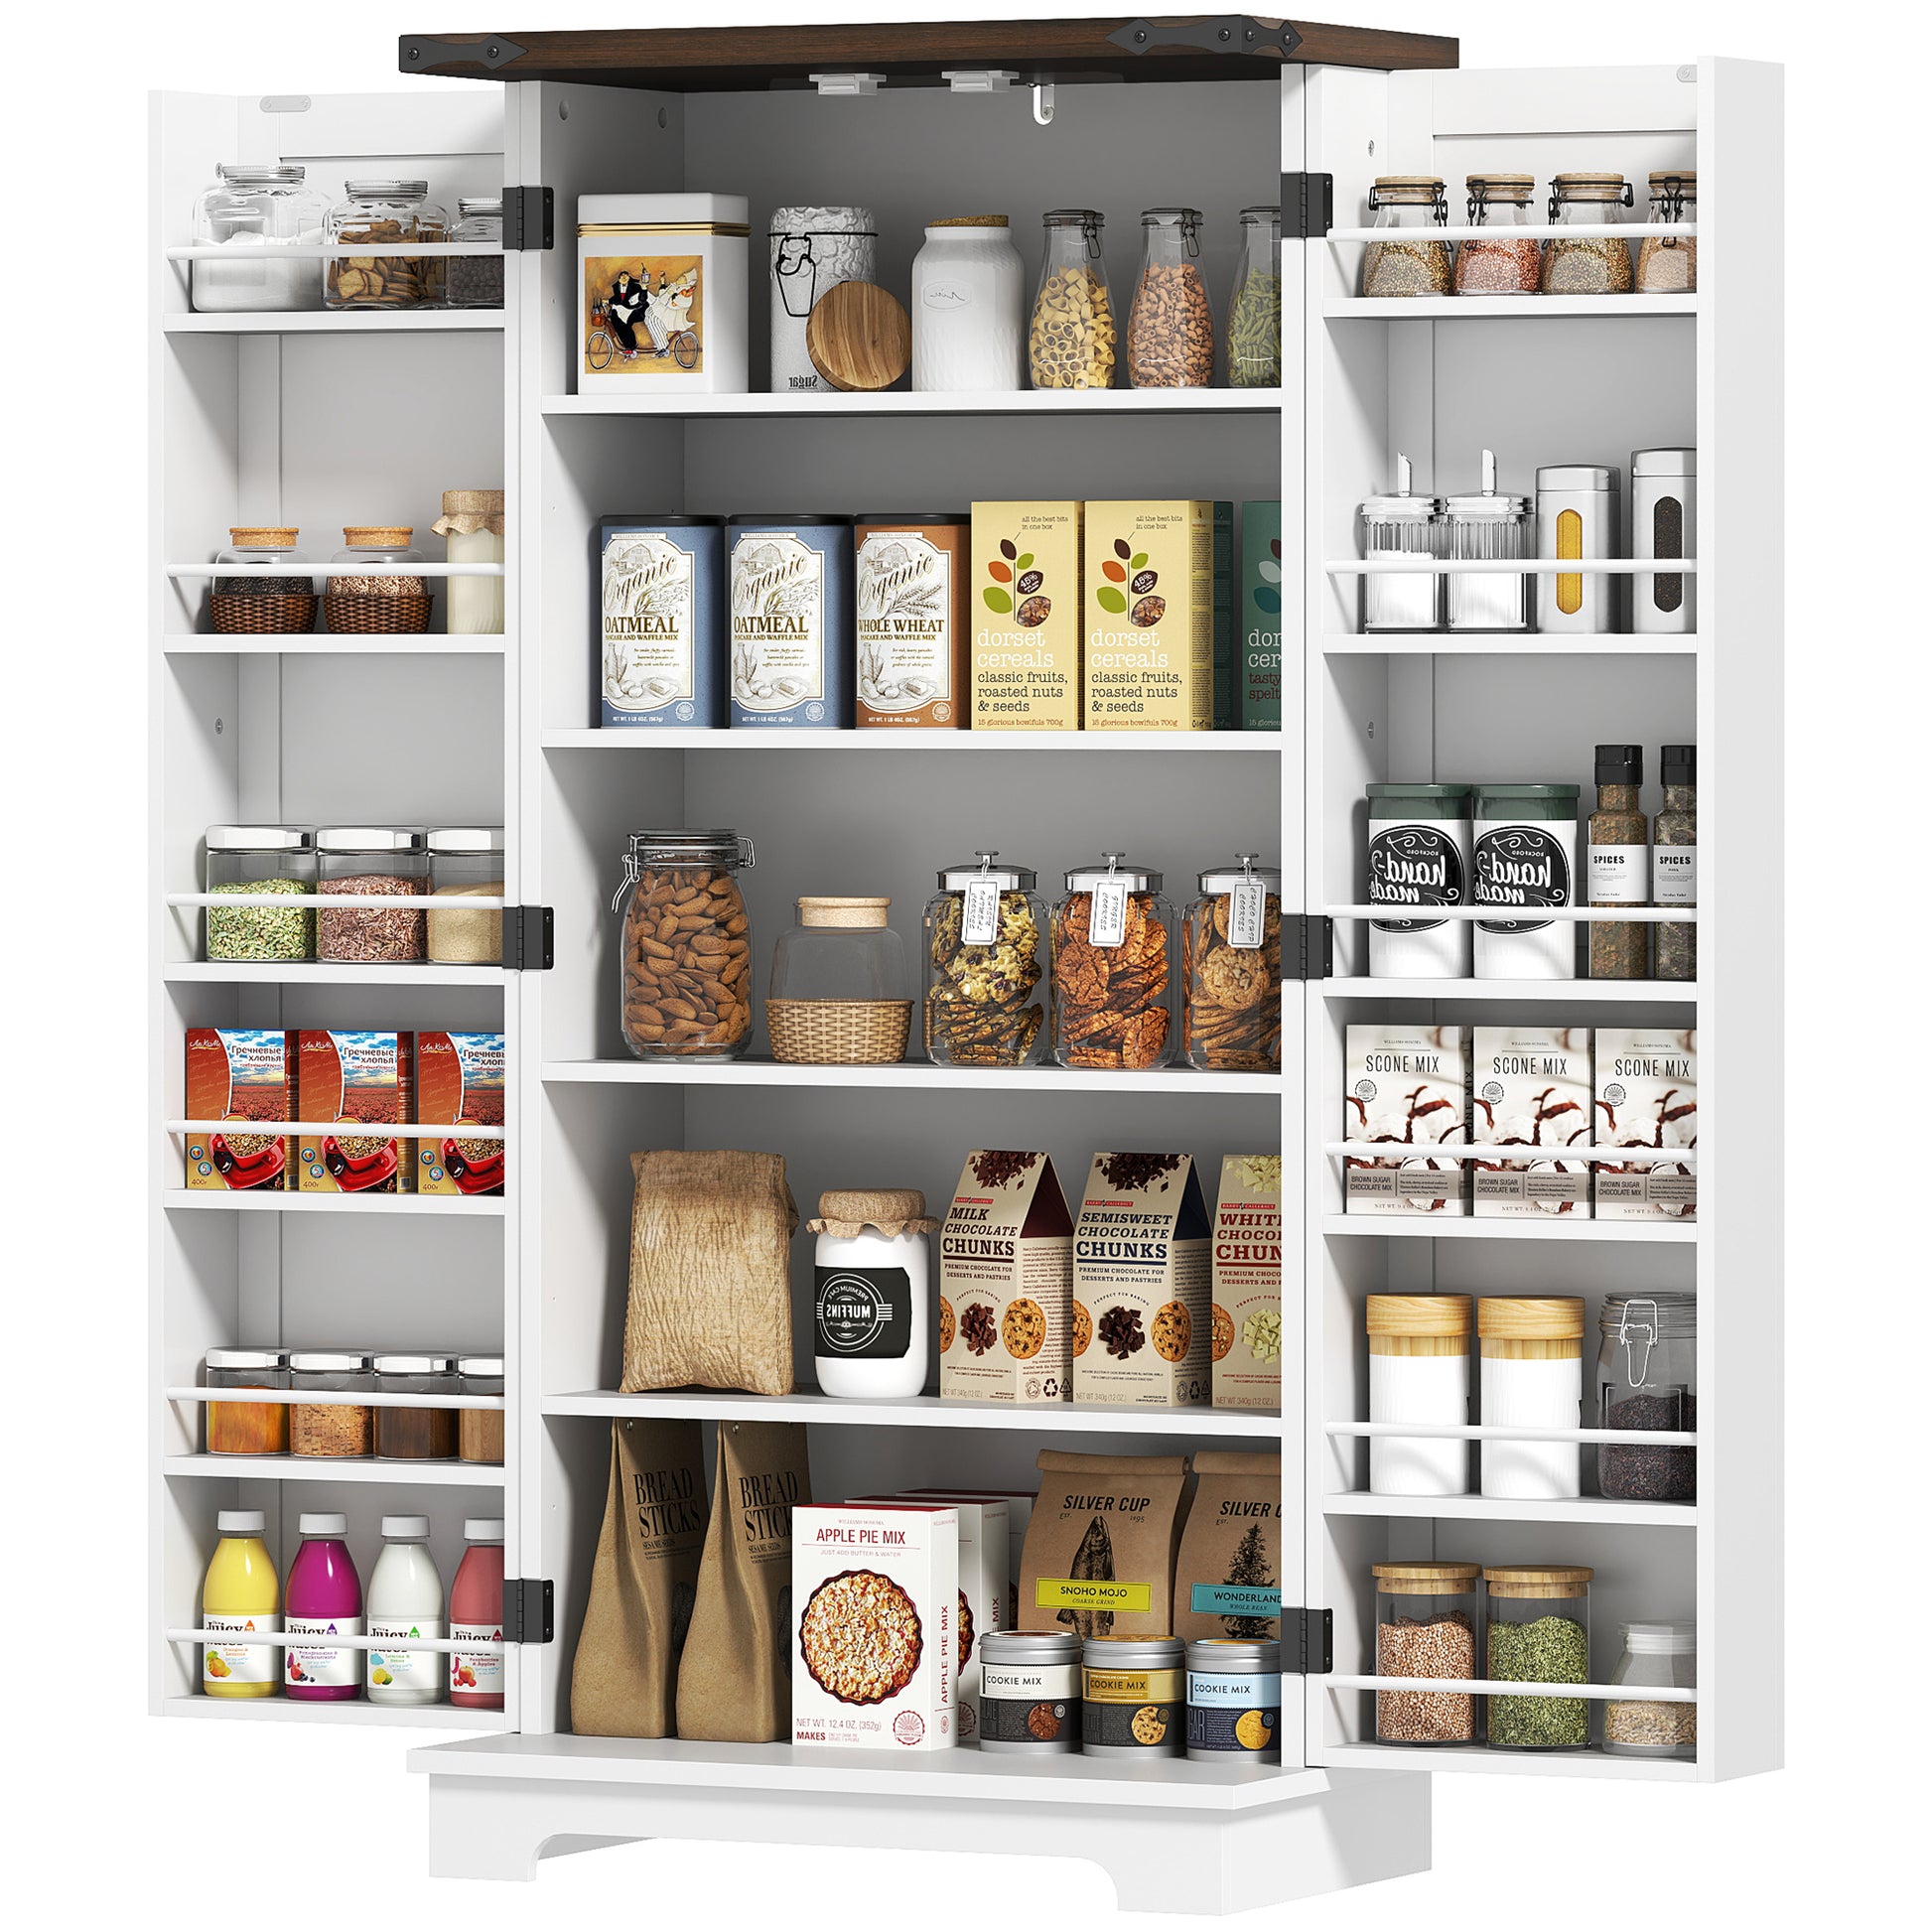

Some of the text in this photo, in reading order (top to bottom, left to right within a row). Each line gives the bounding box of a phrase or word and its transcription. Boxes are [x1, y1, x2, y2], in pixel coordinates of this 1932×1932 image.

[604, 554, 677, 614] Organic
[733, 553, 807, 614] Organic
[859, 553, 934, 614] Organic
[606, 617, 679, 633] OATMEAL
[734, 616, 809, 633] OATMEAL
[859, 619, 944, 632] WHOLE WHEAT
[977, 628, 1045, 646] dorset
[1091, 628, 1160, 646] dorset
[977, 650, 1054, 667] cereals
[1091, 650, 1169, 667] cereals
[978, 671, 1068, 685] classic fruits,
[1092, 671, 1182, 685] classic fruits,
[1249, 672, 1281, 685] tasty
[978, 686, 1063, 697] roasted nuts
[1092, 686, 1177, 697] roasted nuts
[978, 701, 1030, 712] & seeds
[1092, 701, 1144, 712] & seeds
[987, 719, 1014, 728] glorious
[1045, 719, 1063, 728] 700g
[1101, 719, 1128, 728] glorious
[1160, 719, 1177, 728] 700g
[1593, 855, 1625, 865] SPICES
[1659, 856, 1691, 865] SPICES
[231, 1045, 281, 1055] Гречневые
[344, 1047, 394, 1057] Гречневые
[1366, 1054, 1440, 1073] SCONE MIX
[1493, 1056, 1567, 1075] SCONE MIX
[1615, 1059, 1690, 1077] SCONE MIX
[949, 1207, 990, 1220] MILK
[1081, 1212, 1173, 1225] SEMISWEET
[944, 1223, 1018, 1236] CHOCOLATE
[1077, 1226, 1170, 1239] CHOCOLATE
[943, 1237, 1014, 1256] CHUNKS
[1076, 1241, 1167, 1259] CHUNKS
[633, 1467, 694, 1505] BREAD
[738, 1470, 798, 1508] BREAD
[1063, 1495, 1151, 1512] SILVER CUP
[1219, 1501, 1271, 1517] SILVER
[638, 1500, 701, 1538] STICKS
[816, 1528, 905, 1545] APPLE PIE MIX
[1060, 1587, 1128, 1597] SNOHO MOJO
[986, 1676, 1041, 1686] COOKIE MIX
[1090, 1680, 1123, 1690] COOKIE
[1194, 1684, 1228, 1694] COOKIE
[796, 1719, 882, 1731] NET WT. 12.4 OZ. (352g)
[796, 1731, 826, 1741] MAKES
